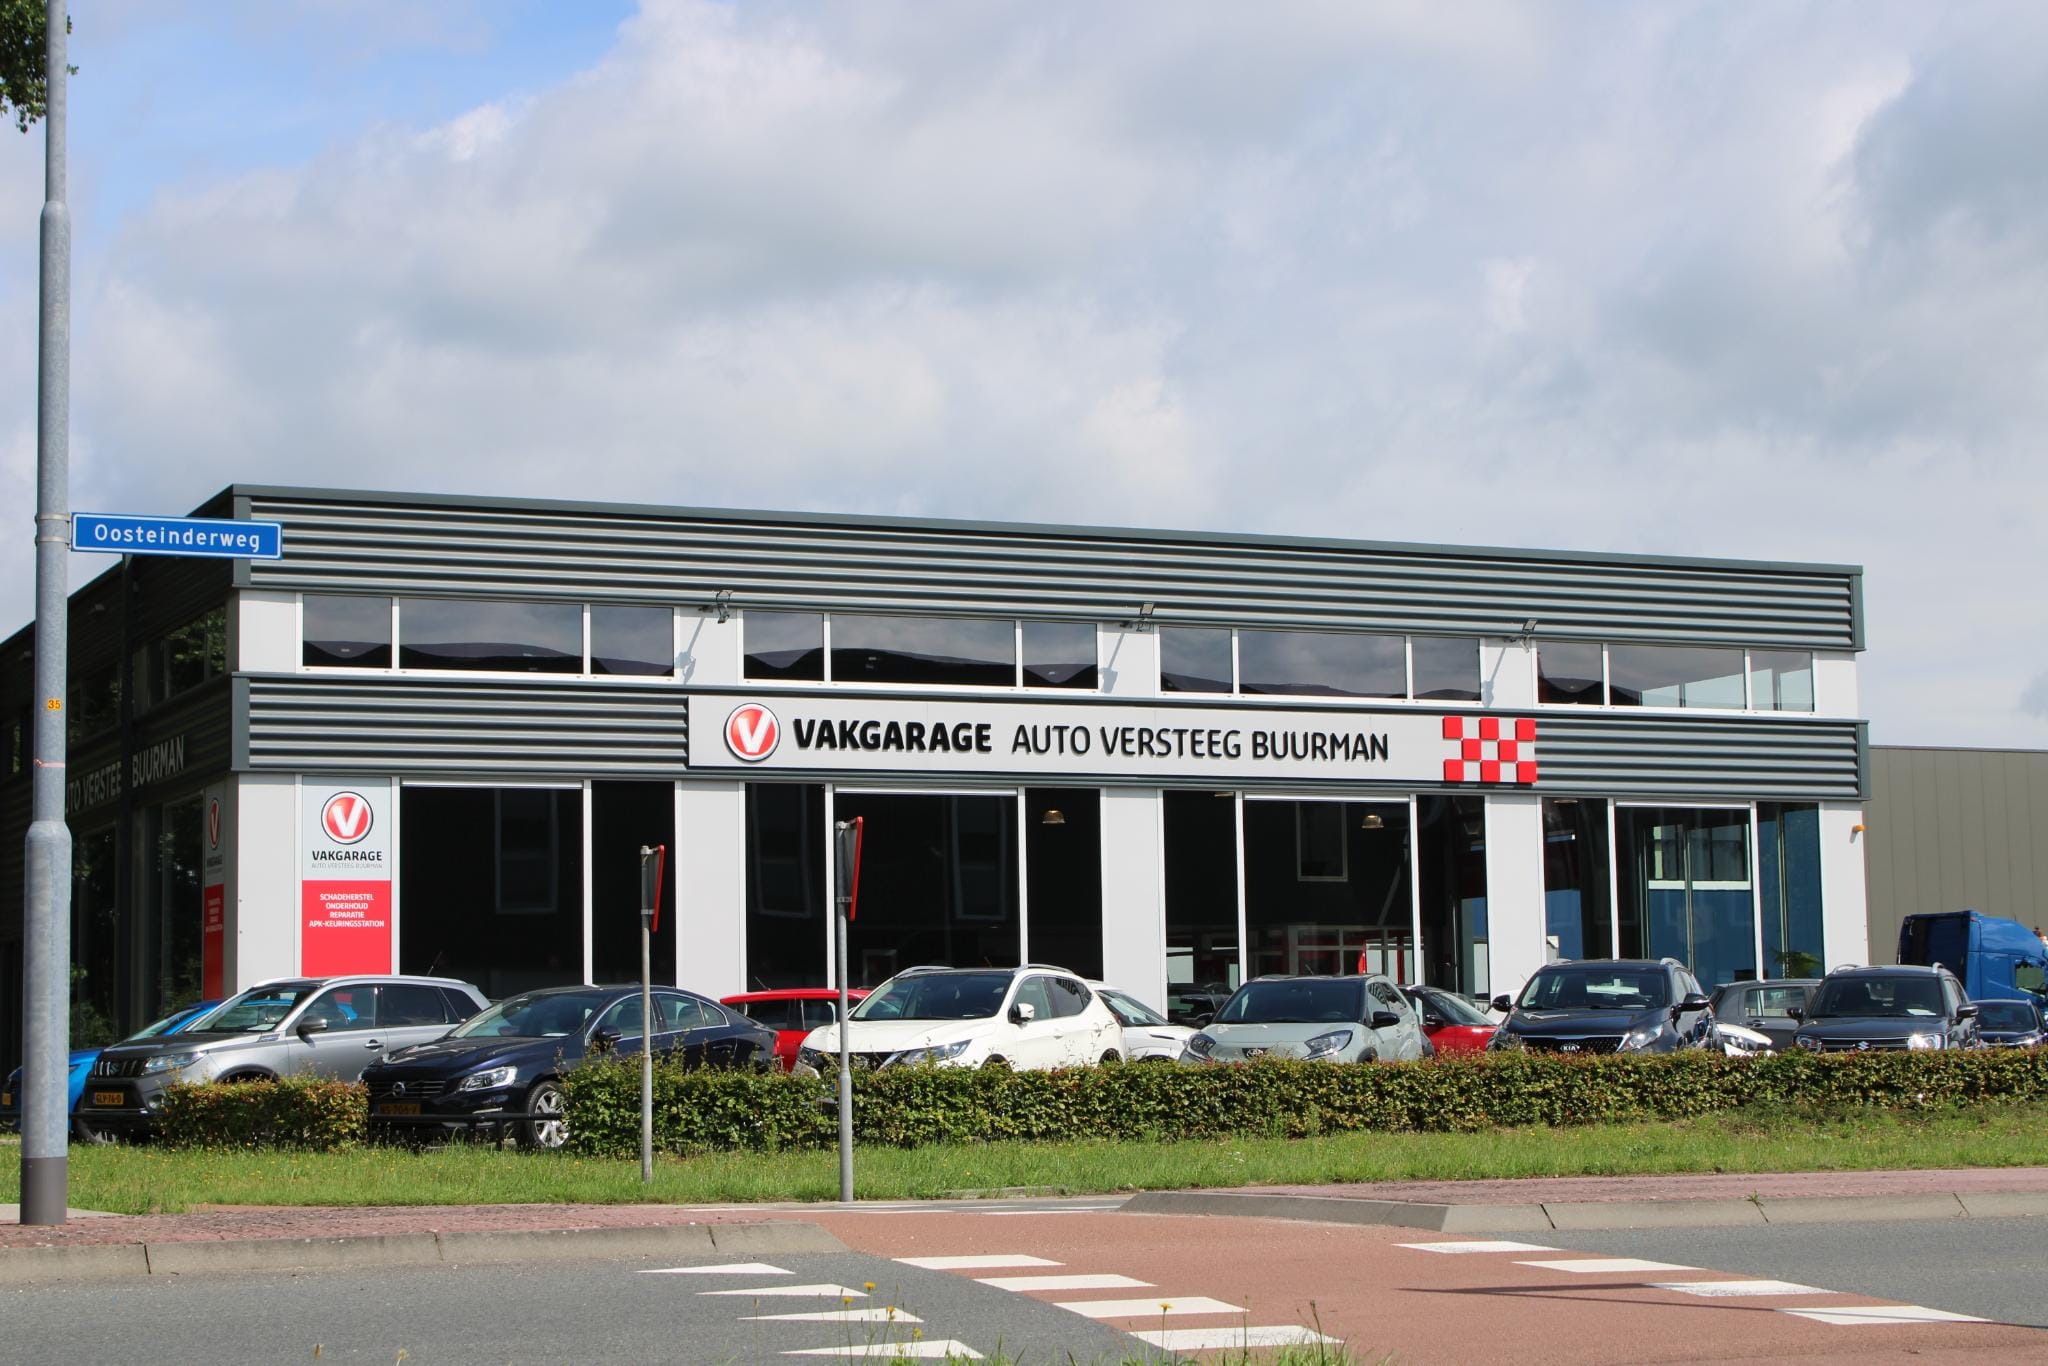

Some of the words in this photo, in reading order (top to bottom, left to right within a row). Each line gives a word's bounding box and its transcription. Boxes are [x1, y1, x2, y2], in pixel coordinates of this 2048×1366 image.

[94, 523, 260, 553] Oosteinderweg
[48, 699, 61, 709] 35
[793, 718, 993, 753] VAKGARAGE
[1012, 724, 1092, 755] AUTO
[1100, 726, 1242, 759] VERSTEEG
[1251, 730, 1389, 761] BUURMAN
[83, 761, 122, 807] VERSTEE
[132, 735, 185, 788] BUURMAN
[312, 850, 383, 861] VAKGARAGE
[320, 893, 374, 901] SCHADEHERSTEL
[325, 902, 369, 910] ONDERHOUD
[329, 911, 365, 919] REPARATIE
[309, 920, 385, 928] APK-KEURINGSSTATION
